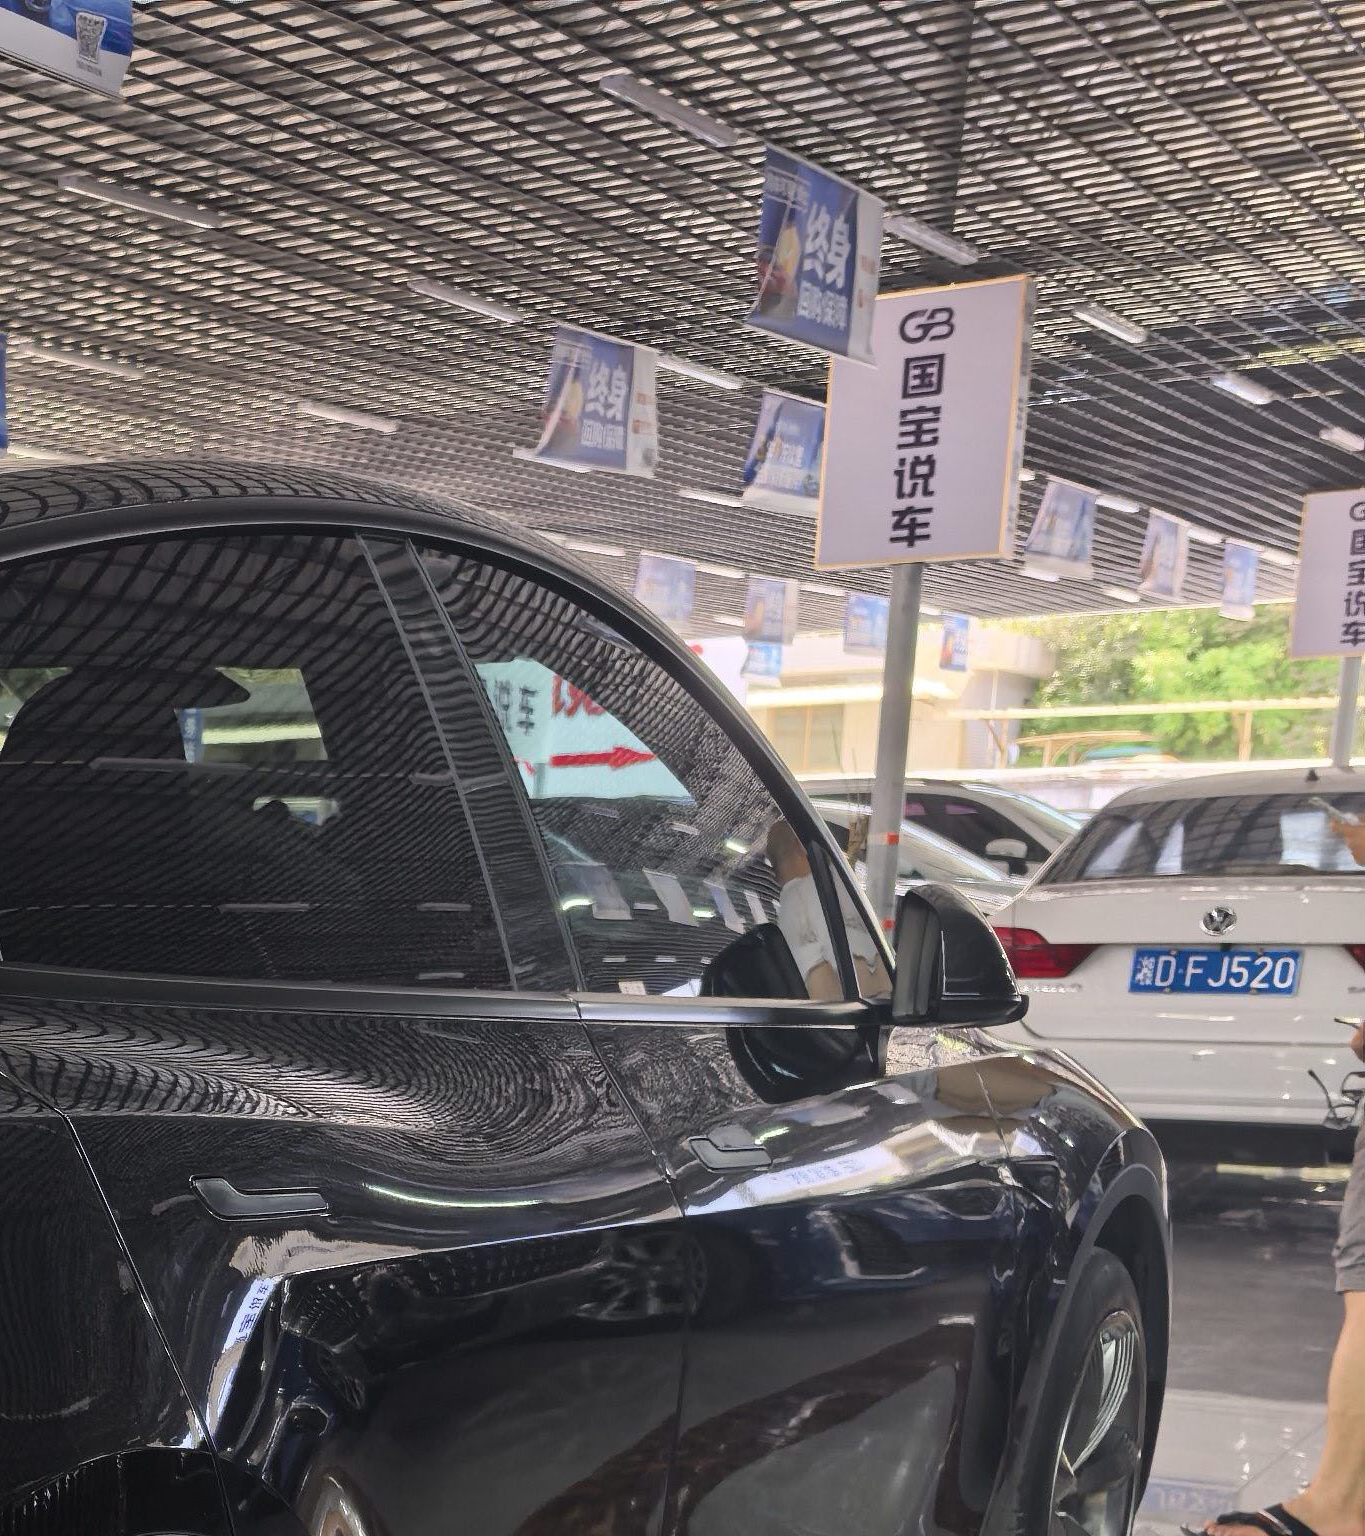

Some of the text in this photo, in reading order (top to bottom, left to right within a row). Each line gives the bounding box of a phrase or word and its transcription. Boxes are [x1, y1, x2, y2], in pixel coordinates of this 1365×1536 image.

[803, 203, 852, 288] 终身
[889, 352, 947, 549] 国宝说车
